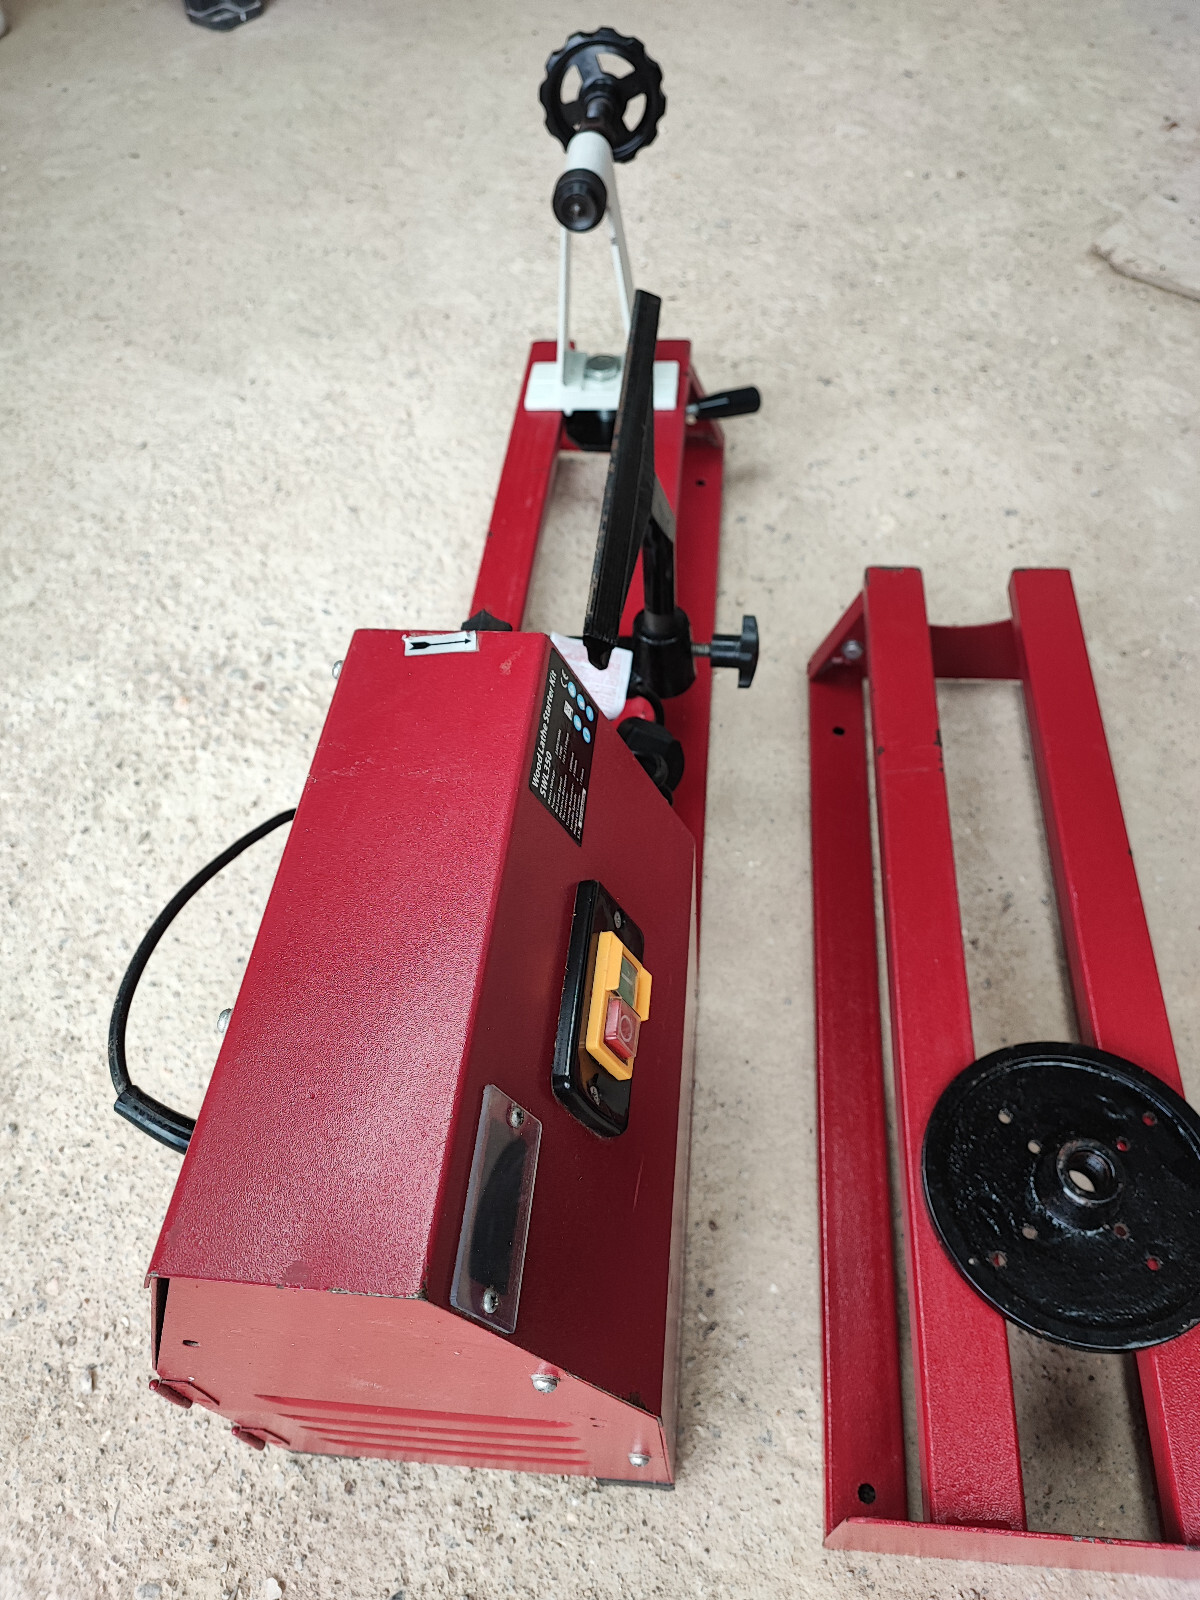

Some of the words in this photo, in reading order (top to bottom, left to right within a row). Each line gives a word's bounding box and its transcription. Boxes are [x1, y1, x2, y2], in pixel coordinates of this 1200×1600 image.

[532, 752, 543, 788] Wood
[538, 723, 548, 755] Lathe
[543, 685, 554, 724] Starter
[549, 670, 557, 687] Kit
[540, 751, 552, 798] SWL350
